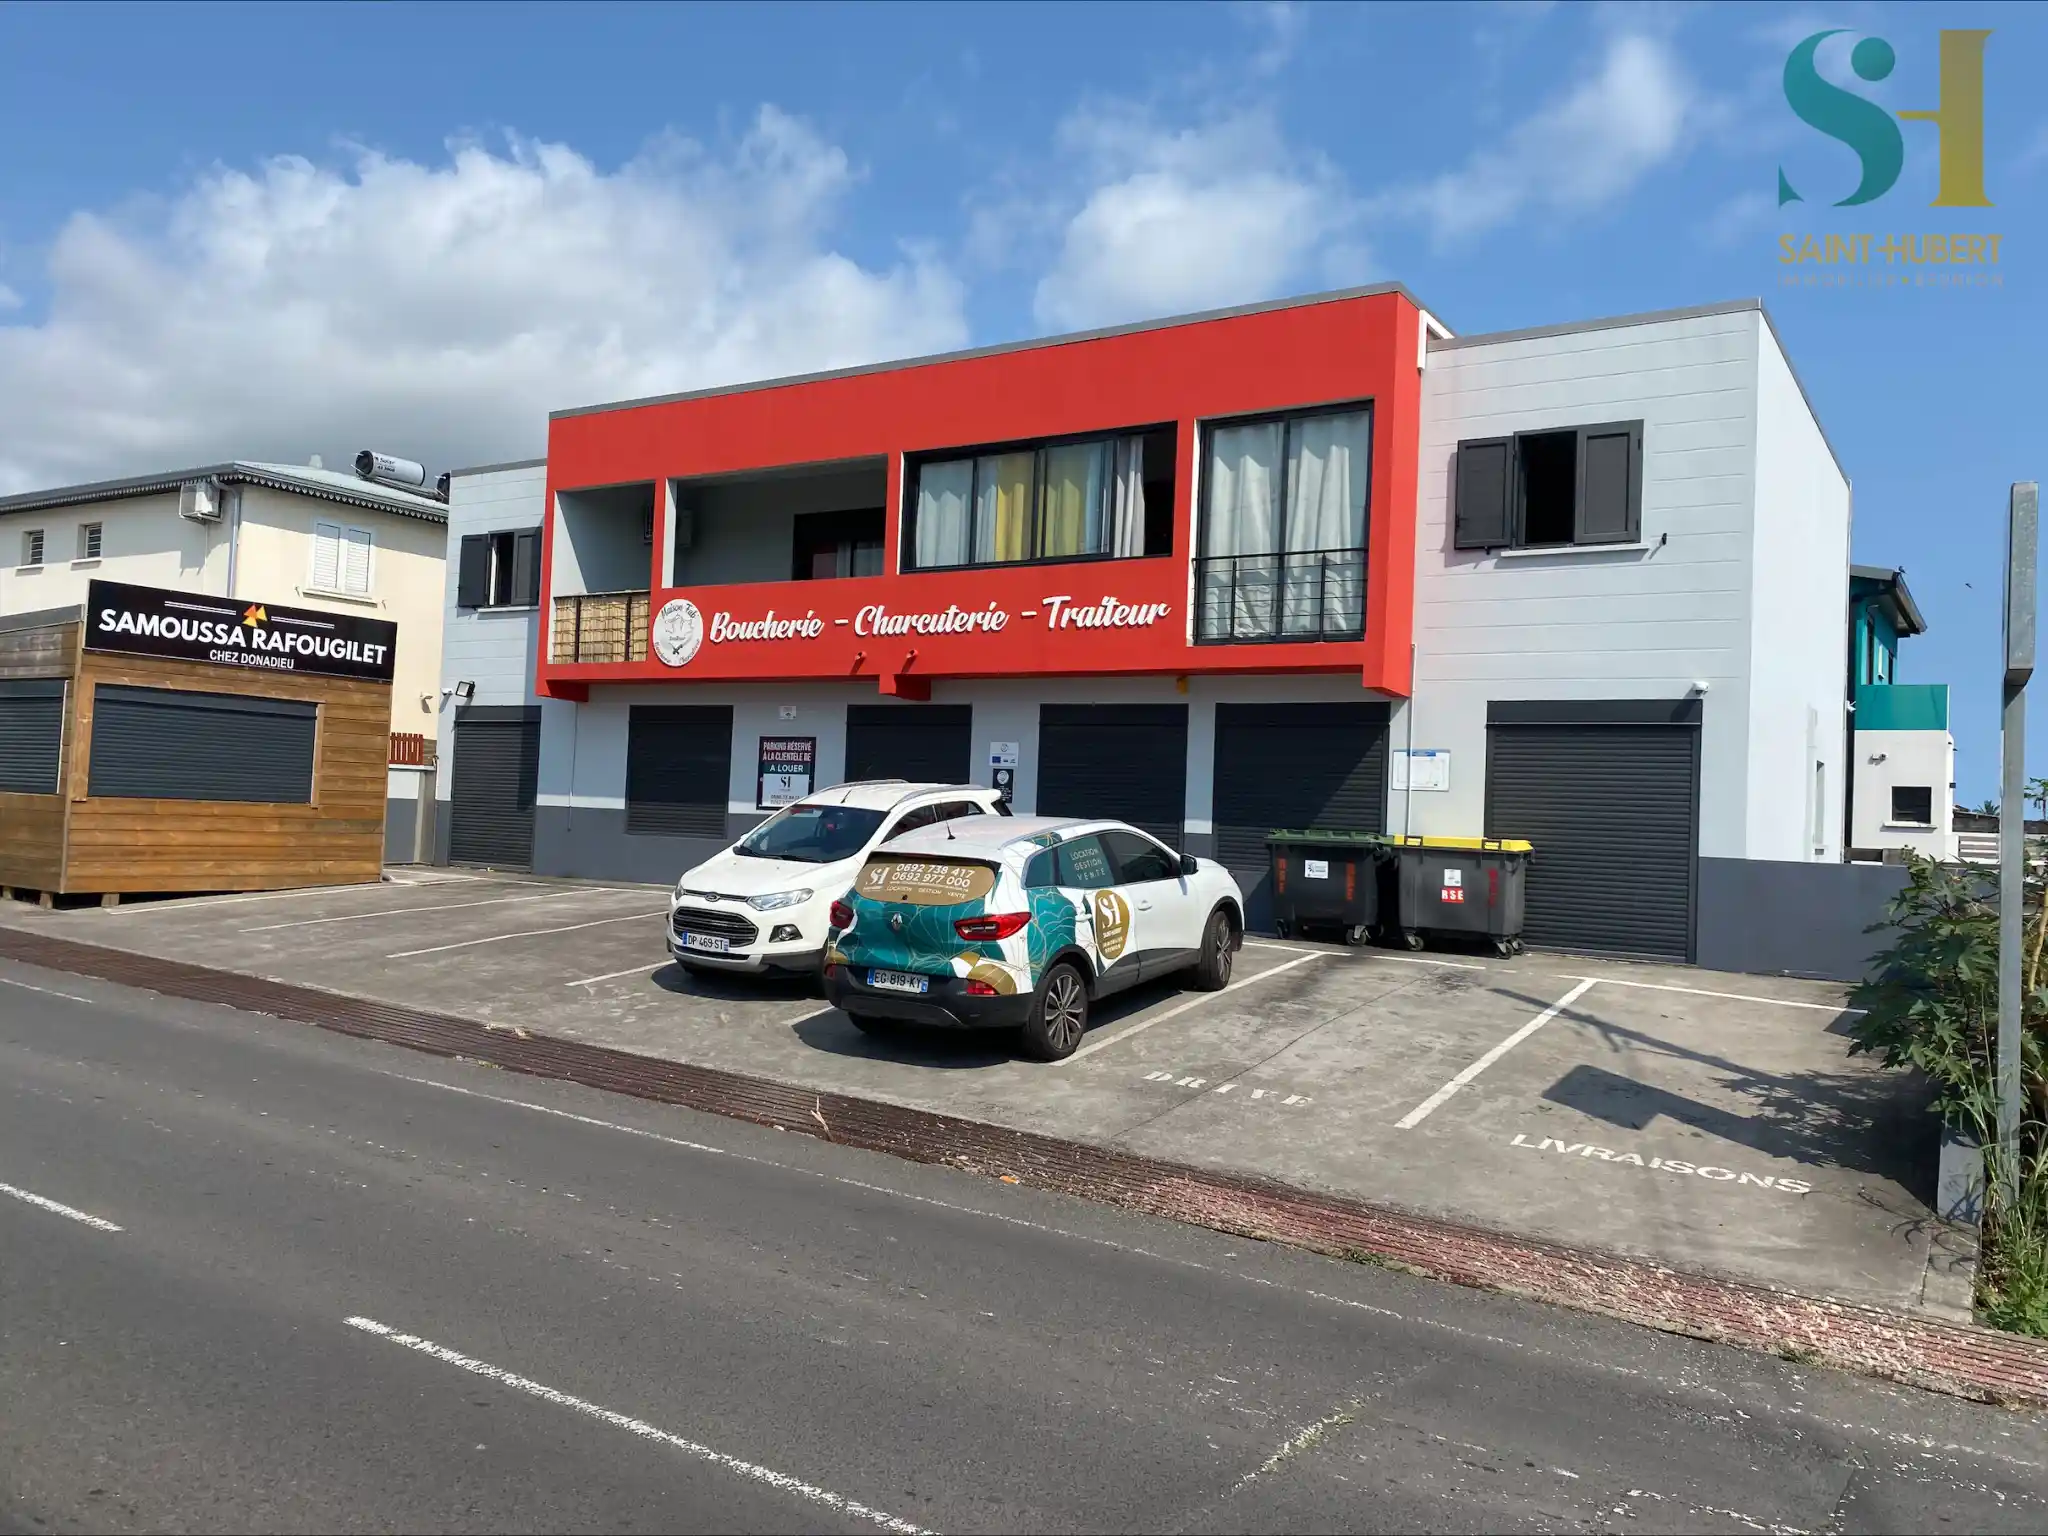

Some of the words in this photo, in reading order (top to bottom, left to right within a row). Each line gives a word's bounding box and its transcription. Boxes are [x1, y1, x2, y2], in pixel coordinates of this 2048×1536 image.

[1042, 595, 1172, 630] Traiteur
[99, 608, 247, 648] SAMOUSSA
[252, 628, 388, 666] RAFOUGILET
[209, 649, 239, 664] CHEZ
[240, 653, 295, 670] DONADIEU
[763, 741, 787, 751] PARKING
[787, 740, 812, 751] RÉSERVÉ
[767, 751, 775, 761] LA
[803, 752, 812, 762] DE
[769, 764, 776, 772] A
[777, 764, 804, 772] LOUER
[896, 863, 926, 873] 0692
[927, 864, 949, 875] 738
[951, 867, 976, 879] 417
[1074, 858, 1102, 871] GESTION
[891, 872, 921, 882] 0692
[922, 873, 945, 884] 977
[946, 876, 971, 889] 000
[1076, 867, 1105, 881] VENTE
[1510, 1134, 1812, 1194] LIVRAISONS
